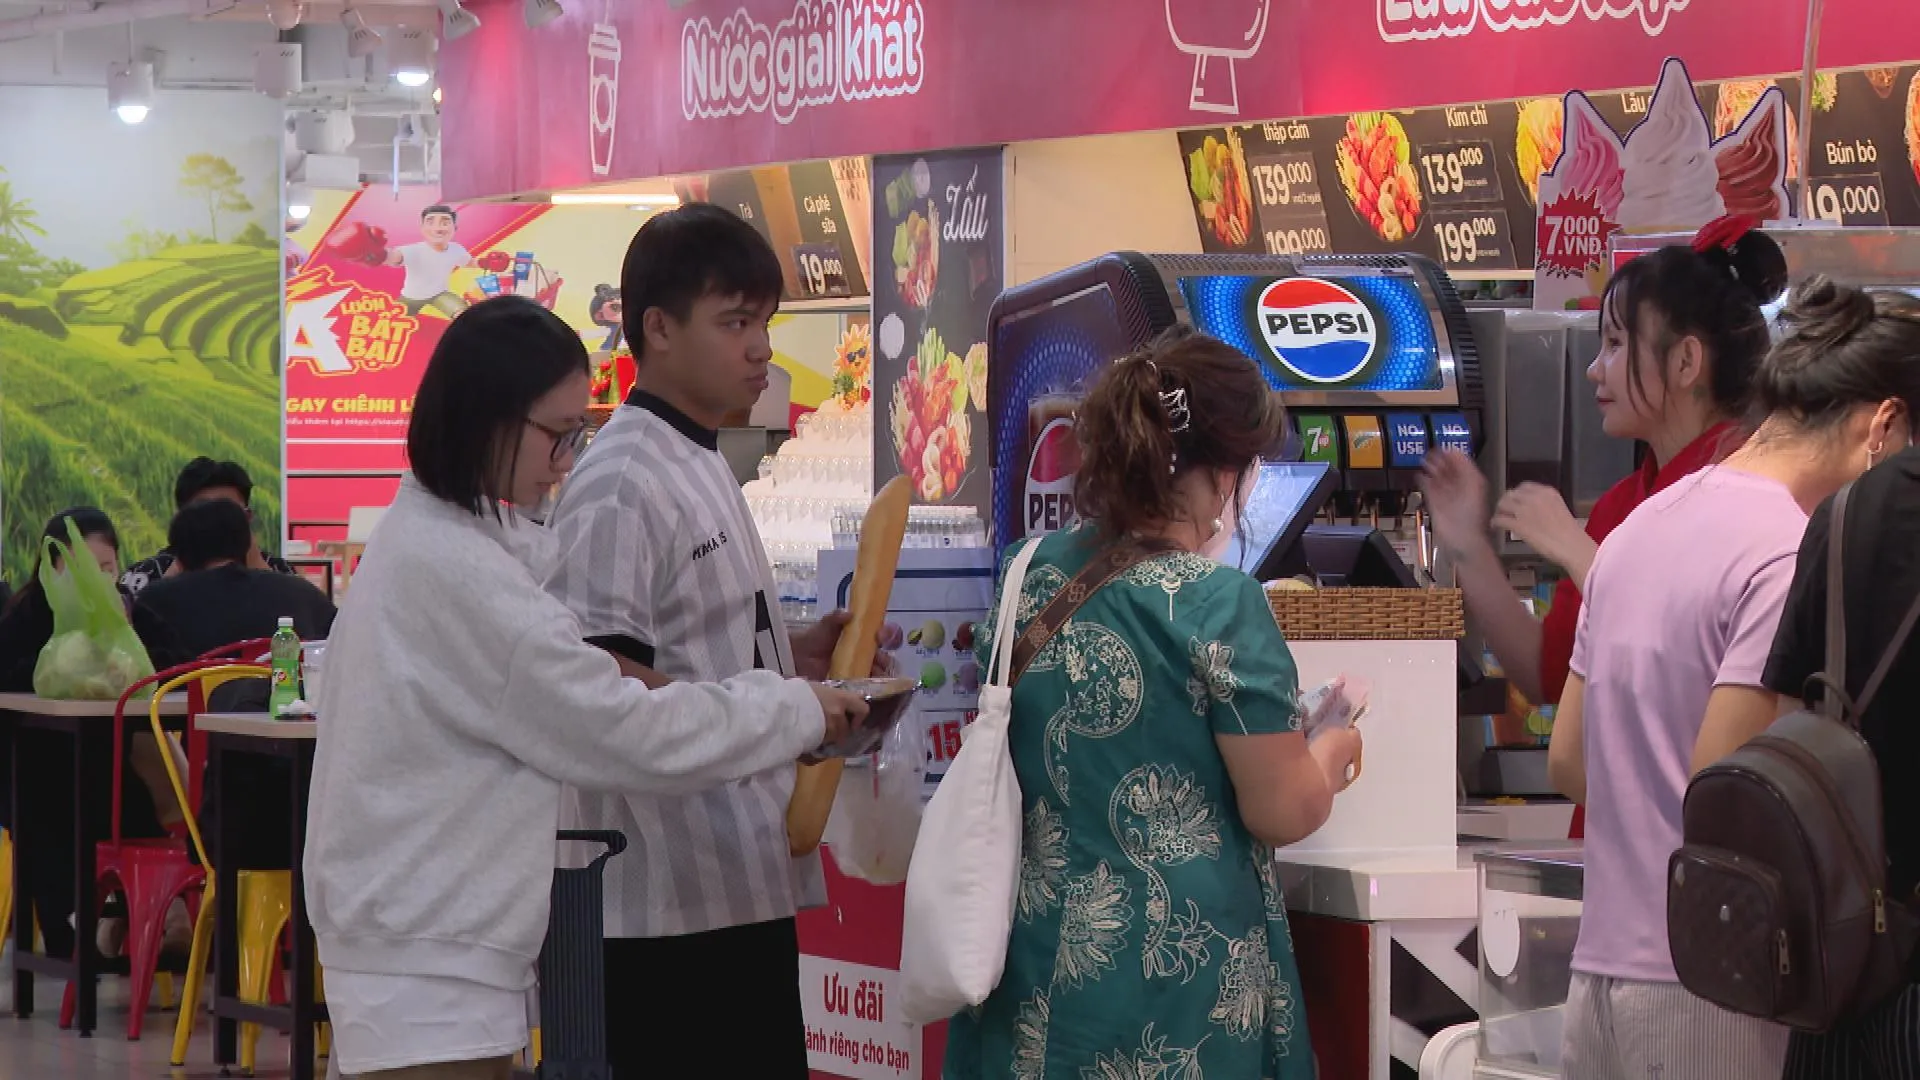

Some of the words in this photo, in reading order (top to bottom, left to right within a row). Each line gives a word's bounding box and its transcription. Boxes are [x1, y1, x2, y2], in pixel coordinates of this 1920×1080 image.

[685, 24, 768, 104] Nước
[776, 5, 834, 107] giải
[844, 1, 918, 84] khát
[1445, 107, 1470, 127] Kim
[1470, 104, 1489, 126] chi
[1825, 141, 1855, 164] Bún
[1855, 139, 1877, 163] bò
[341, 296, 386, 315] LUÔN
[1265, 312, 1369, 335] PEPSI
[346, 338, 399, 366] BẠI
[332, 392, 395, 413] CHÊNH
[401, 394, 416, 413] L
[1397, 425, 1420, 437] NO
[1397, 441, 1424, 455] USE
[824, 971, 849, 1016] Ưu
[853, 979, 883, 1023] đãi
[803, 1023, 827, 1053] ành
[829, 1030, 860, 1065] riêng
[862, 1037, 884, 1065] cho
[886, 1041, 910, 1076] bạn
